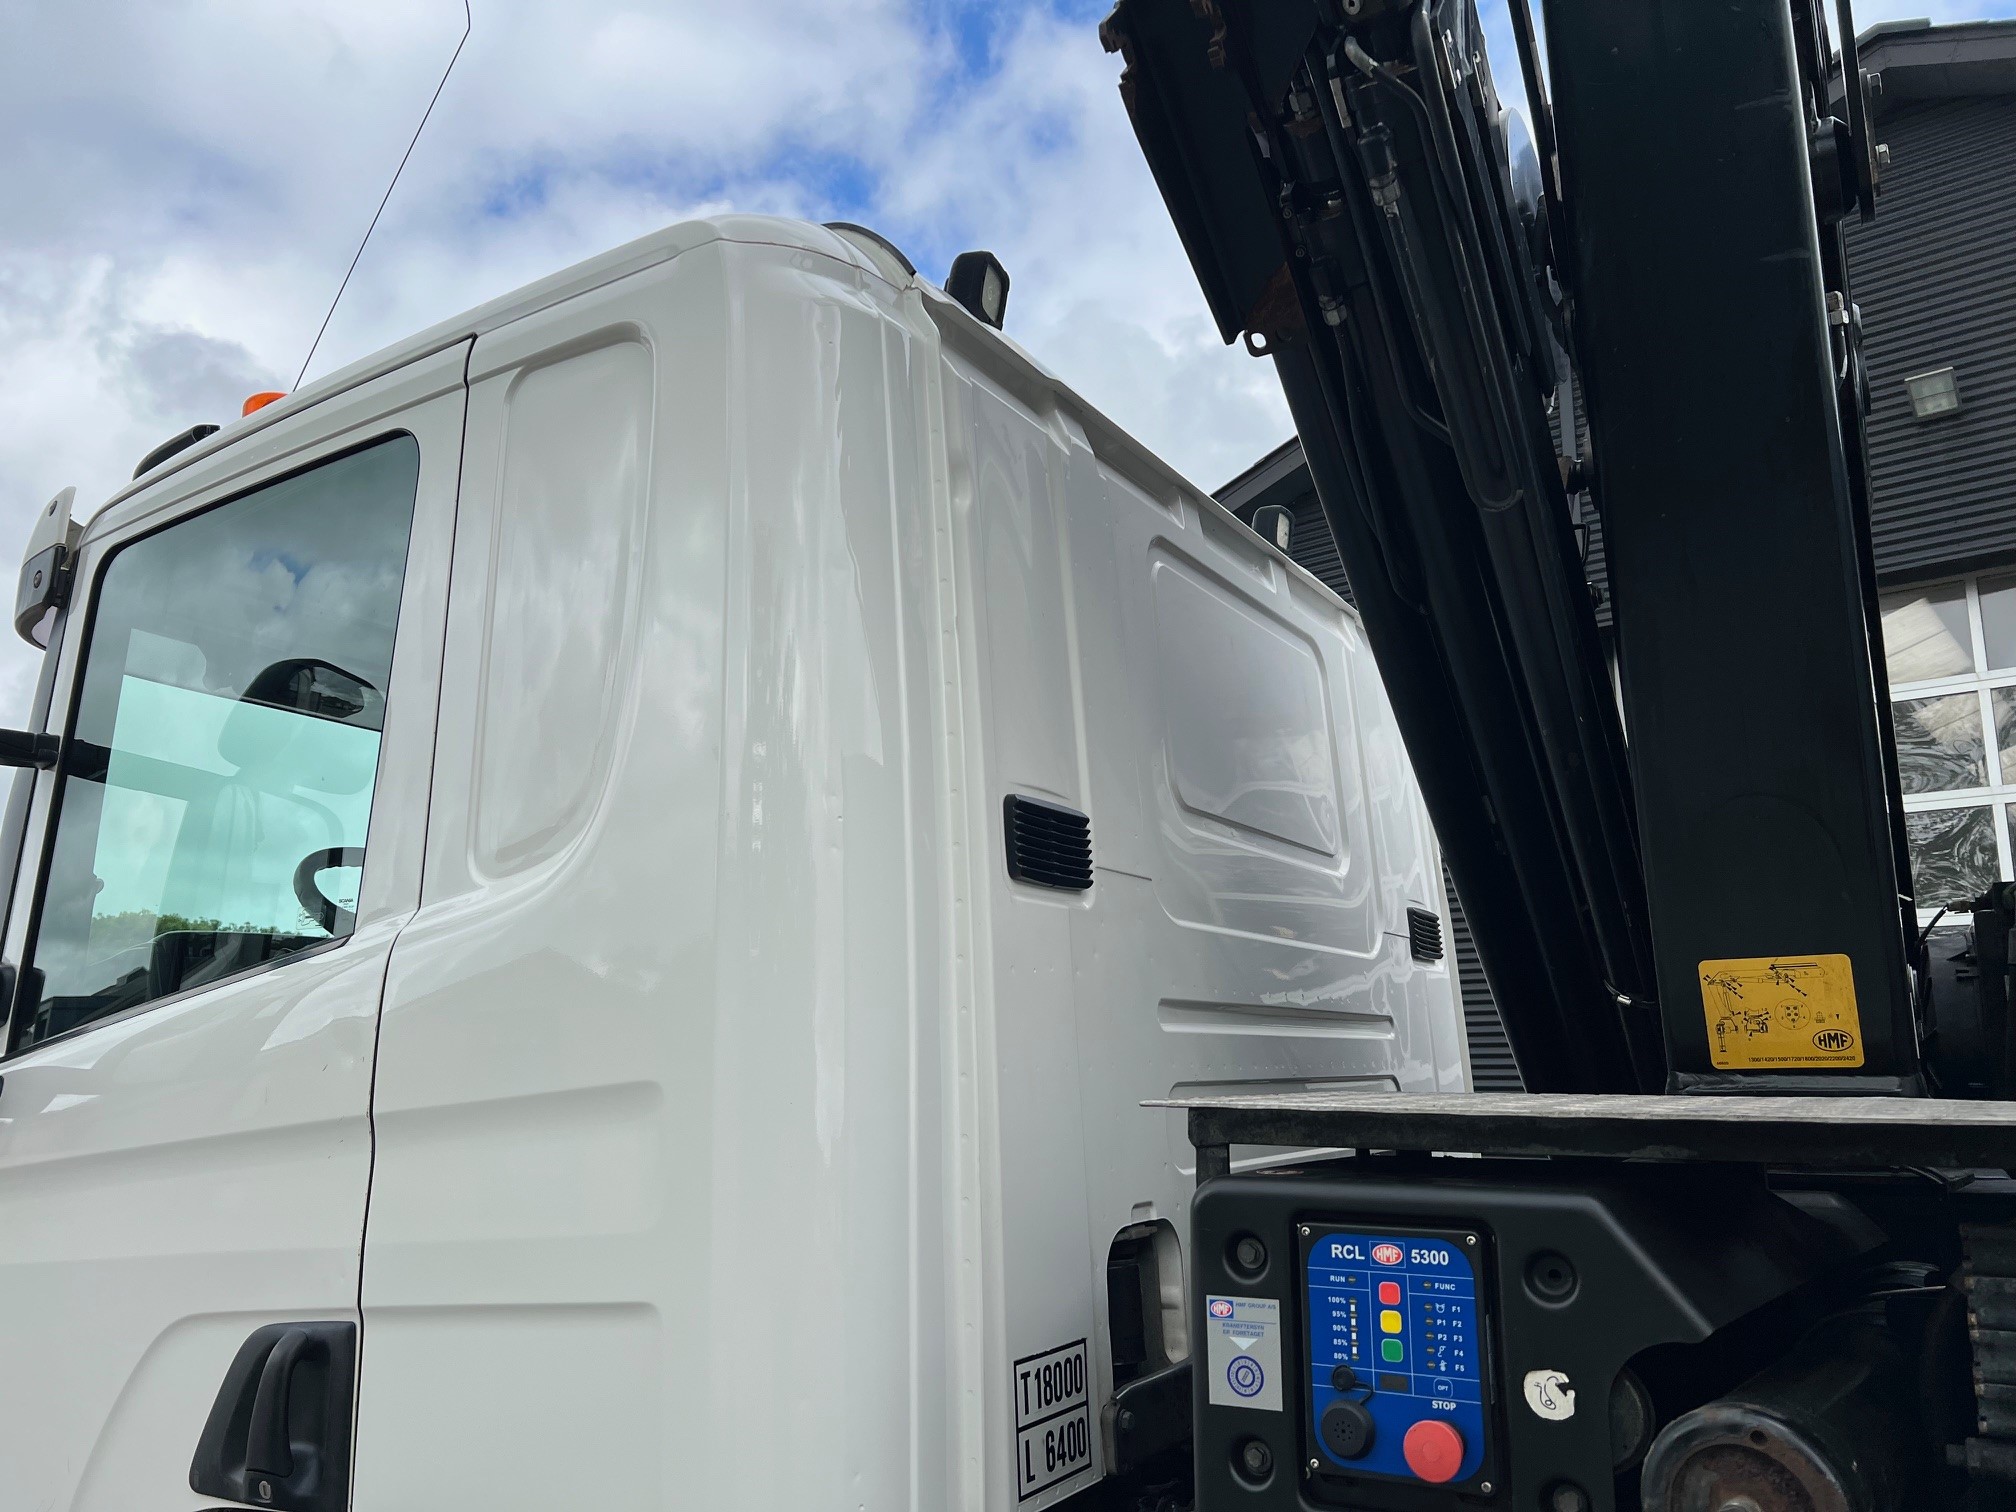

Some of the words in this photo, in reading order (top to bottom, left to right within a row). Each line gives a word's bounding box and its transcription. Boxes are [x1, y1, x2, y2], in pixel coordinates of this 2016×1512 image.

[1818, 1033, 1849, 1048] HMF
[1331, 1244, 1365, 1260] RCL
[1376, 1247, 1399, 1262] HMF
[1411, 1249, 1449, 1265] 5300
[1328, 1296, 1346, 1304] 100%
[1213, 1302, 1230, 1316] HMF
[1332, 1310, 1346, 1318] 95%
[1438, 1333, 1447, 1341] P2
[1333, 1352, 1348, 1360] 80%
[1454, 1349, 1464, 1357] F4
[1432, 1400, 1457, 1410] STOP
[1024, 1439, 1036, 1484] L
[1045, 1416, 1087, 1473] 6400
